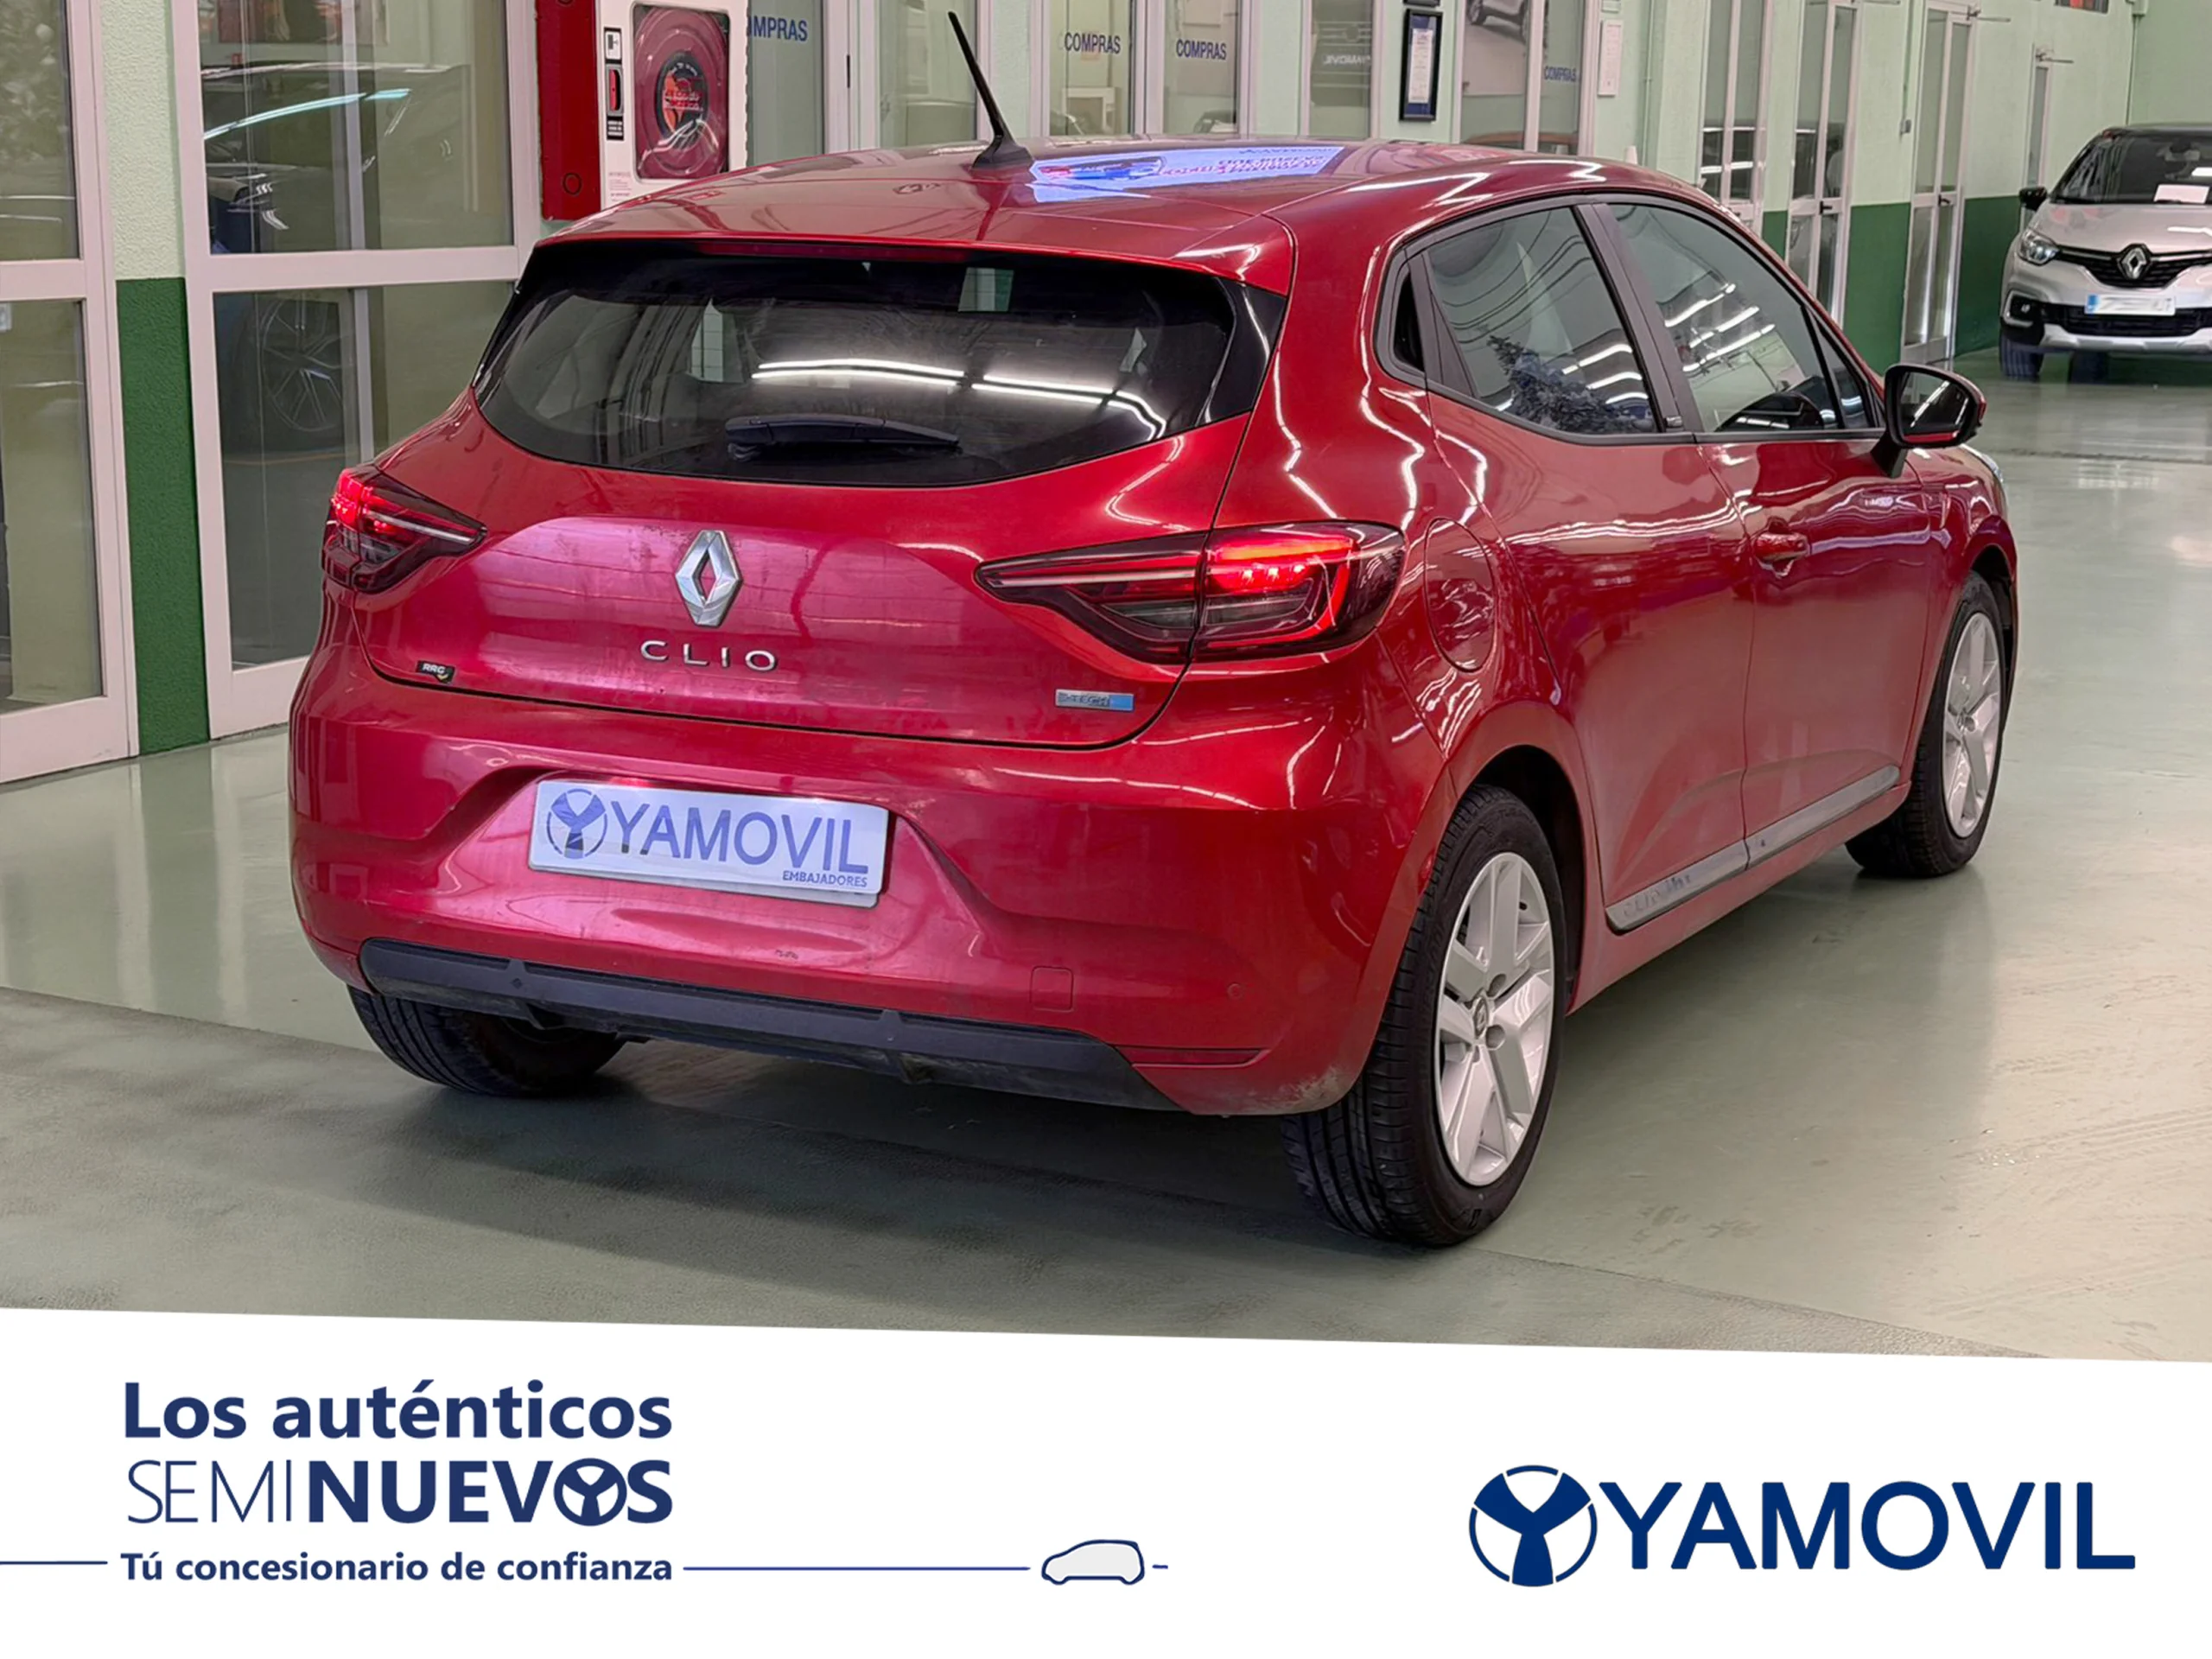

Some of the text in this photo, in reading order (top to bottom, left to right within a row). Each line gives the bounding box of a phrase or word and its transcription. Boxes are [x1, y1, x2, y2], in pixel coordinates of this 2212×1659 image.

[747, 15, 808, 41] MPRAS
[1065, 32, 1121, 54] COMPRAS
[1176, 39, 1227, 60] COMPRAS
[640, 640, 776, 671] CLIO
[611, 801, 868, 874] YAMOVIL
[782, 870, 868, 888] EMBAJADORES
